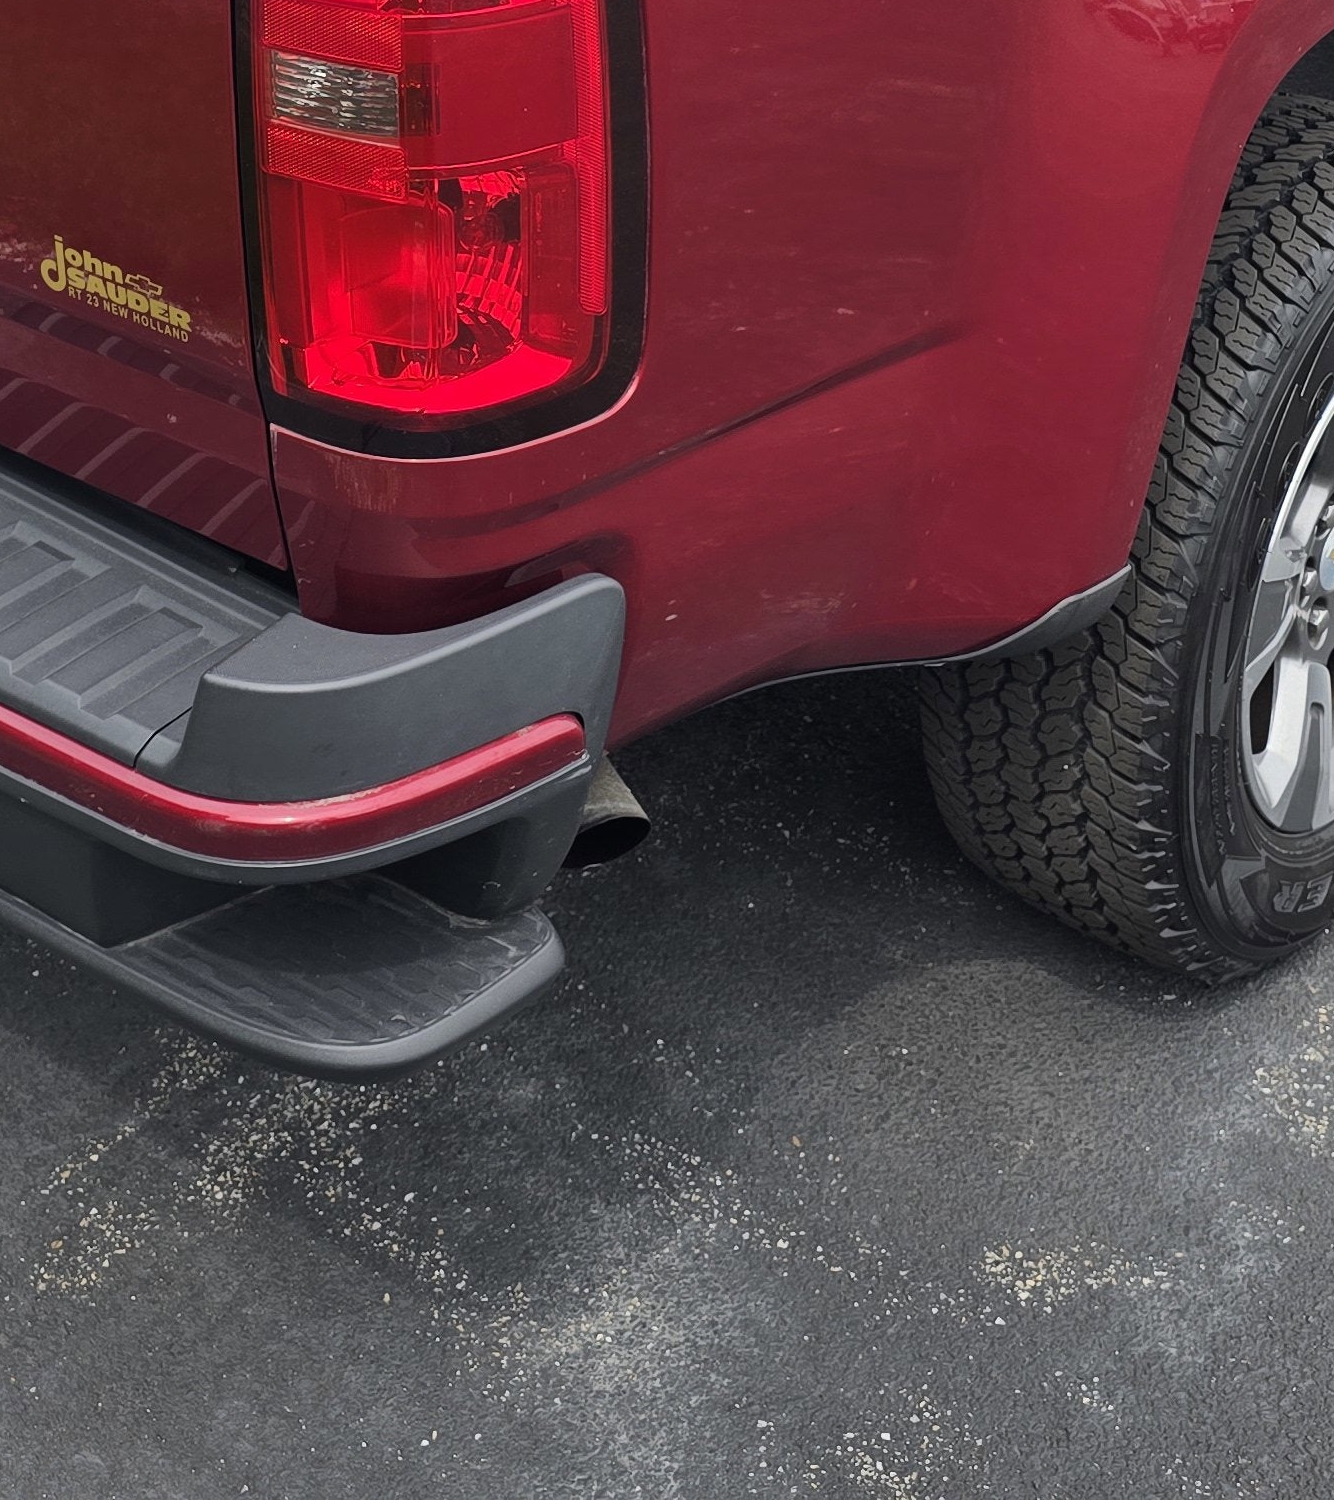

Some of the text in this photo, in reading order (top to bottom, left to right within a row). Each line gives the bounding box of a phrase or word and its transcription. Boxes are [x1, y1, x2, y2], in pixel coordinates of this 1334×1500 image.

[66, 266, 193, 332] SAUDER
[67, 287, 189, 343] RT 23 NEW HOLLAND
